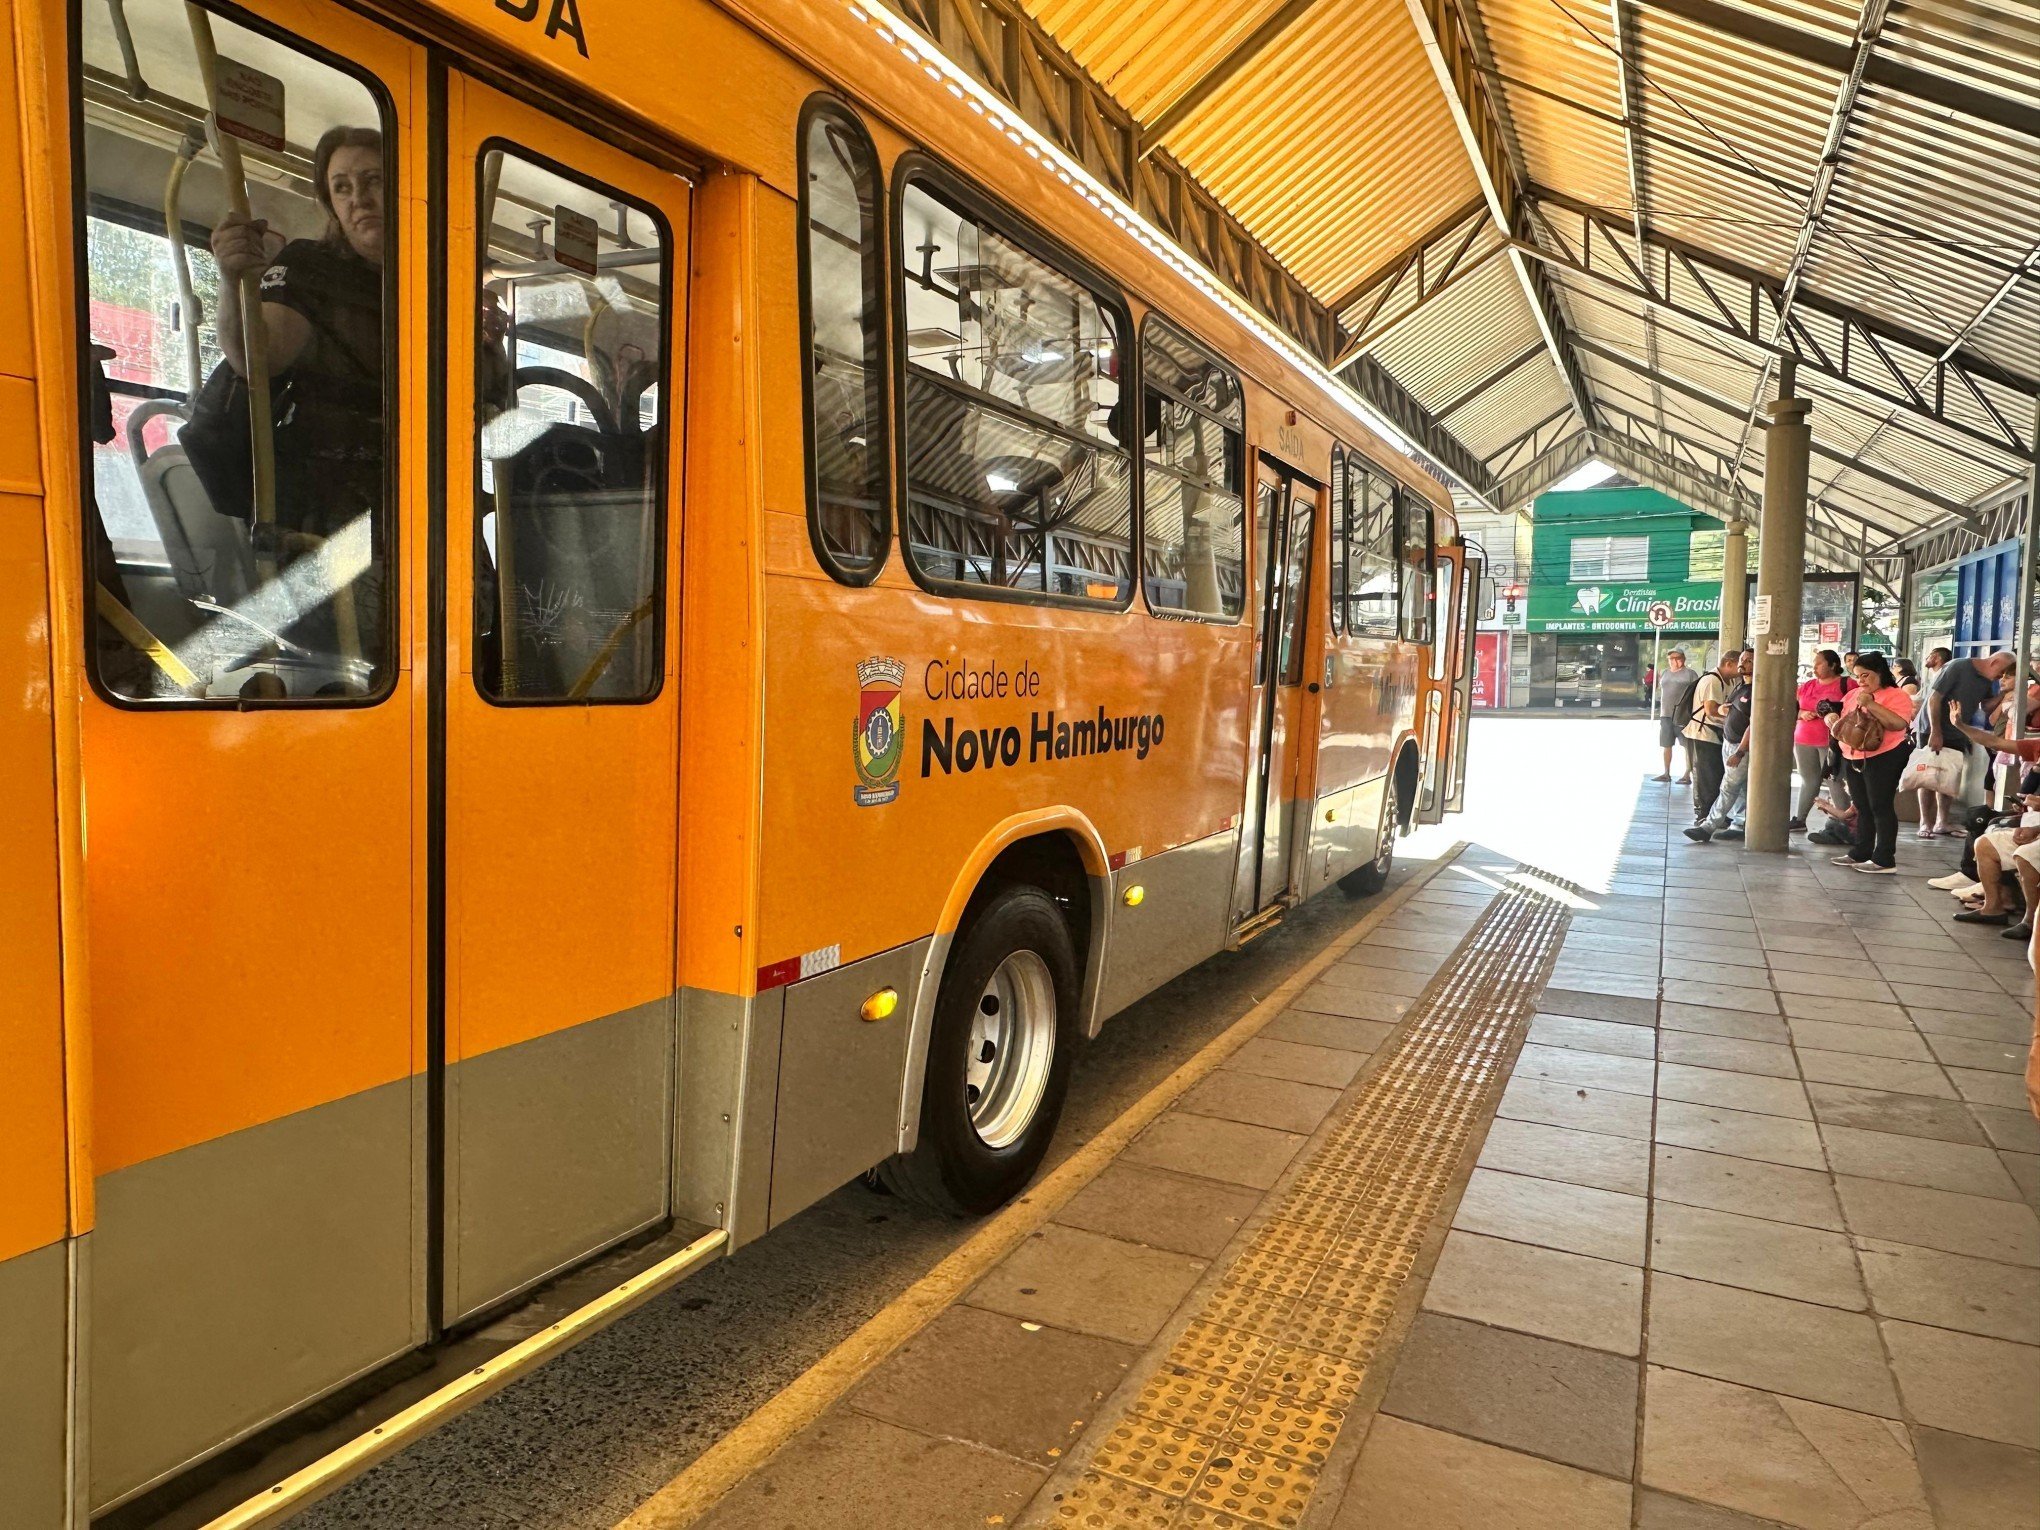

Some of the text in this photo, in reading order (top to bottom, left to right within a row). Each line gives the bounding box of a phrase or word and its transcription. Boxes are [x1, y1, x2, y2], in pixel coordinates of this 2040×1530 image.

[1615, 596, 1671, 613] Clíni
[1545, 622, 1586, 631] IMPLANTES
[1591, 622, 1636, 631] ORTODONTIA
[1680, 621, 1707, 630] FACIAL
[924, 658, 1040, 701] Cidade de
[921, 705, 1165, 778] Novo Hamburgo
